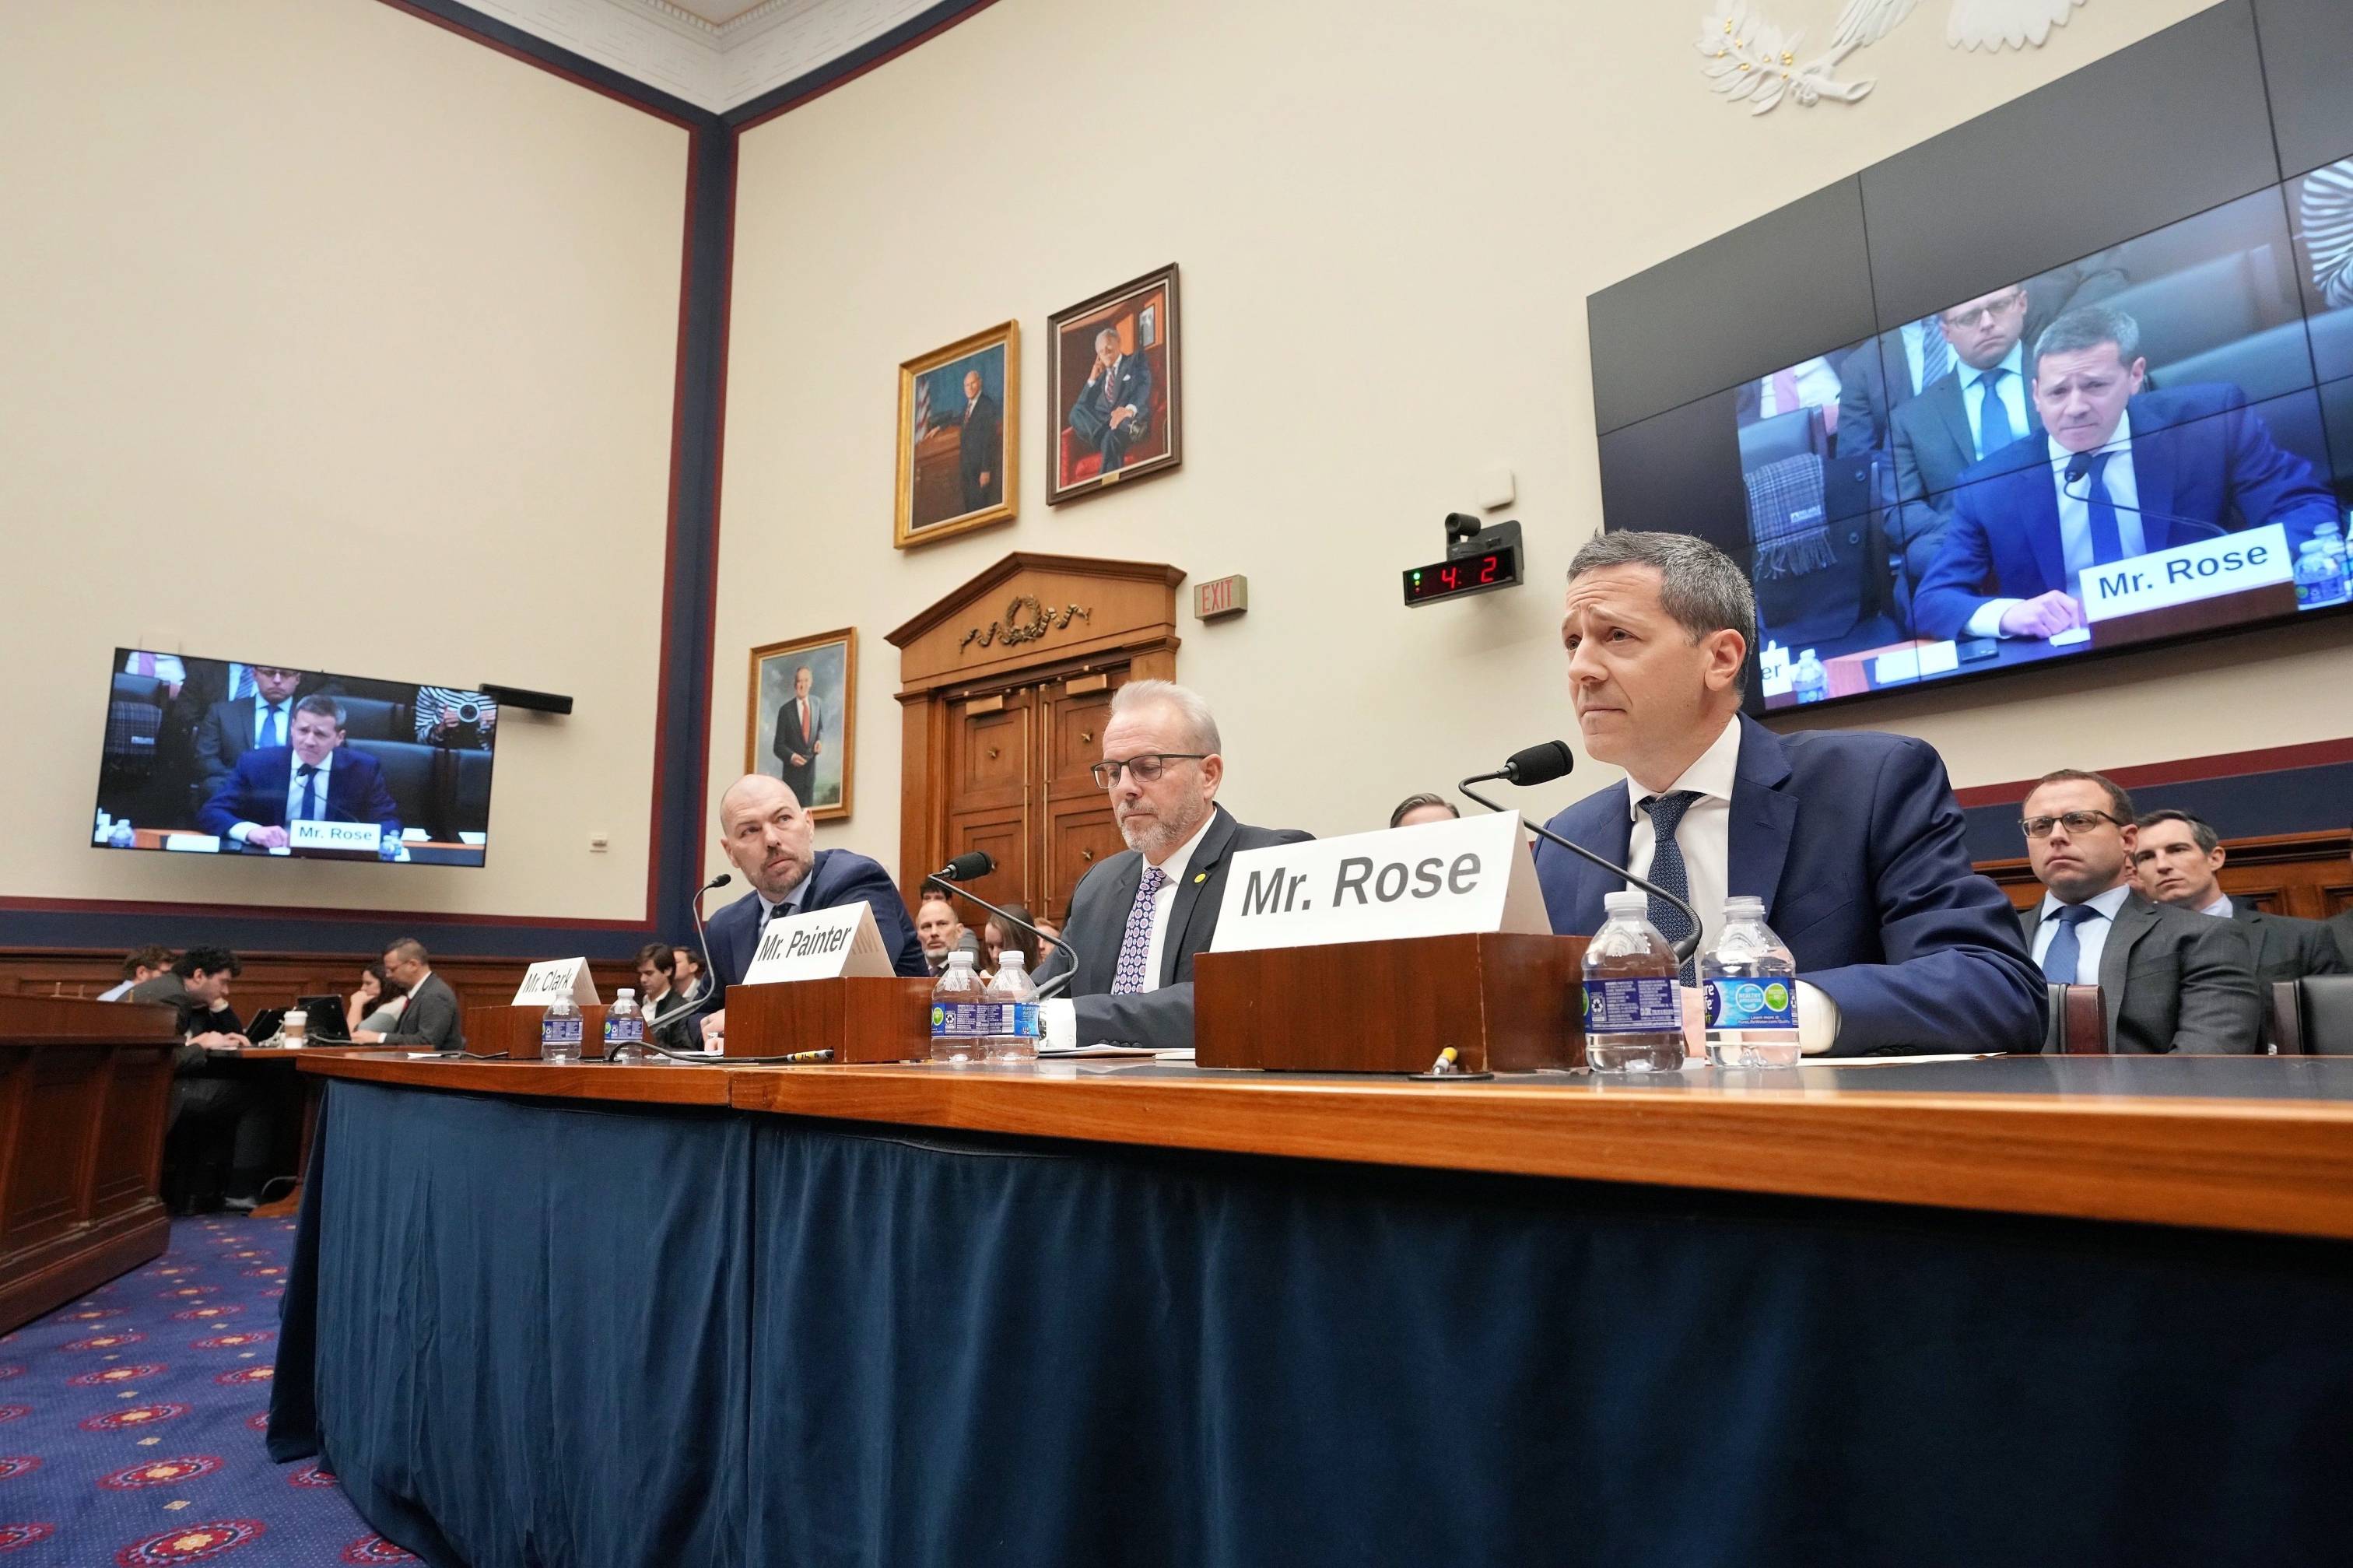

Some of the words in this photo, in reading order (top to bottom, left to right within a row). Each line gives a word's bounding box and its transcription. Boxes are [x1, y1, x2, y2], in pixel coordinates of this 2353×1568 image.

[2099, 573, 2153, 599] Mr.
[2166, 546, 2268, 584] Rose
[1201, 577, 1233, 613] EXIT
[300, 826, 324, 839] Mr.
[331, 828, 372, 840] Rose
[1241, 867, 1311, 917] Mr.
[1332, 853, 1482, 908] Rose
[757, 934, 784, 962] Mr.
[785, 925, 852, 959] Painter
[522, 973, 540, 993] Mr.
[542, 967, 573, 992] Clark
